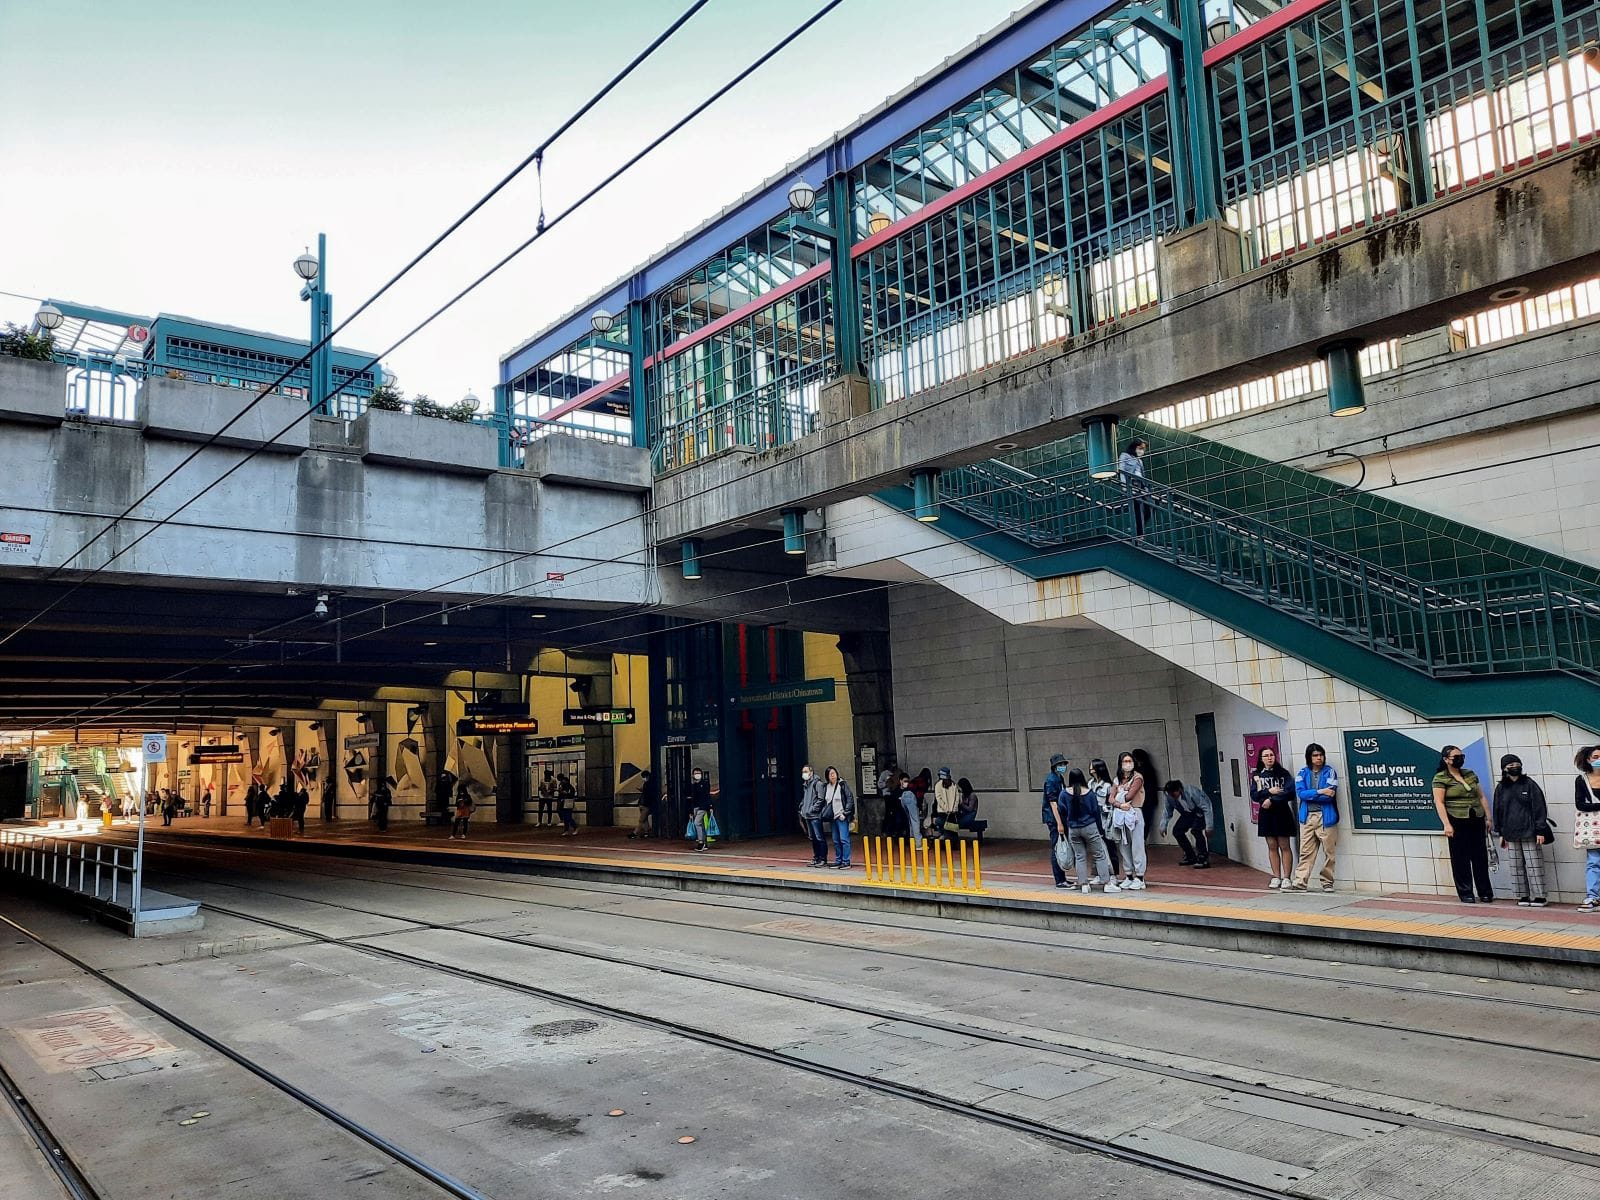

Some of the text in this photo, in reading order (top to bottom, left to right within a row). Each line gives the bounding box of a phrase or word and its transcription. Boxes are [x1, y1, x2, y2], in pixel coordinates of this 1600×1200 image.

[1353, 738, 1378, 747] aws
[1356, 764, 1416, 776] Build your
[1357, 776, 1424, 787] cloud skills
